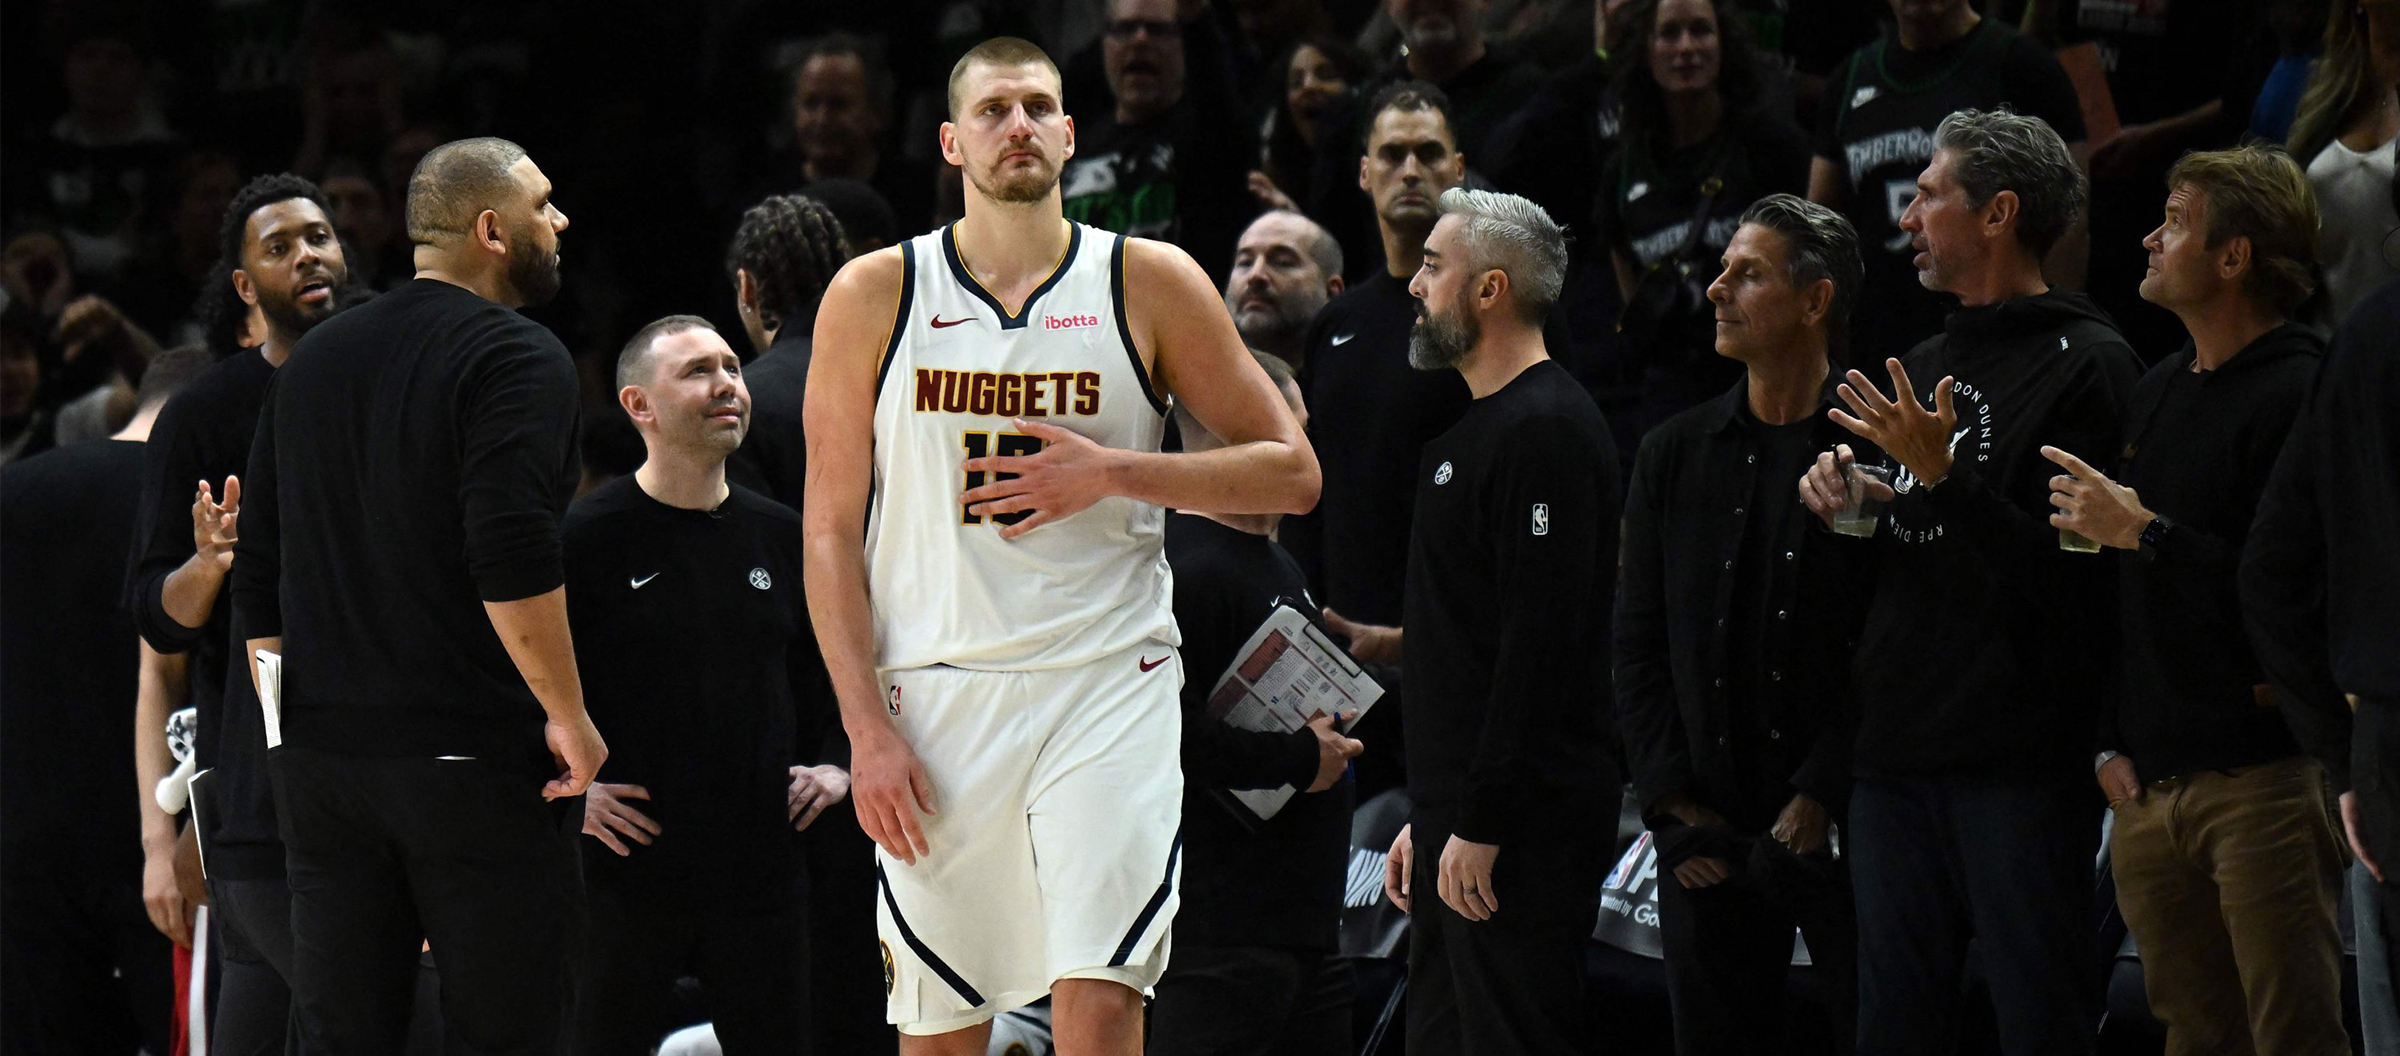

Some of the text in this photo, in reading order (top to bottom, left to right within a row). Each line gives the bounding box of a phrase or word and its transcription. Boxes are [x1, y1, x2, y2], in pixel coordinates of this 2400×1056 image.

[1843, 126, 1939, 194] TIMBERWO
[1045, 314, 1098, 330] ibotta
[915, 367, 1100, 418] NUGGETS
[1928, 381, 1992, 462] BDON DUNES
[1919, 524, 1943, 543] RPE
